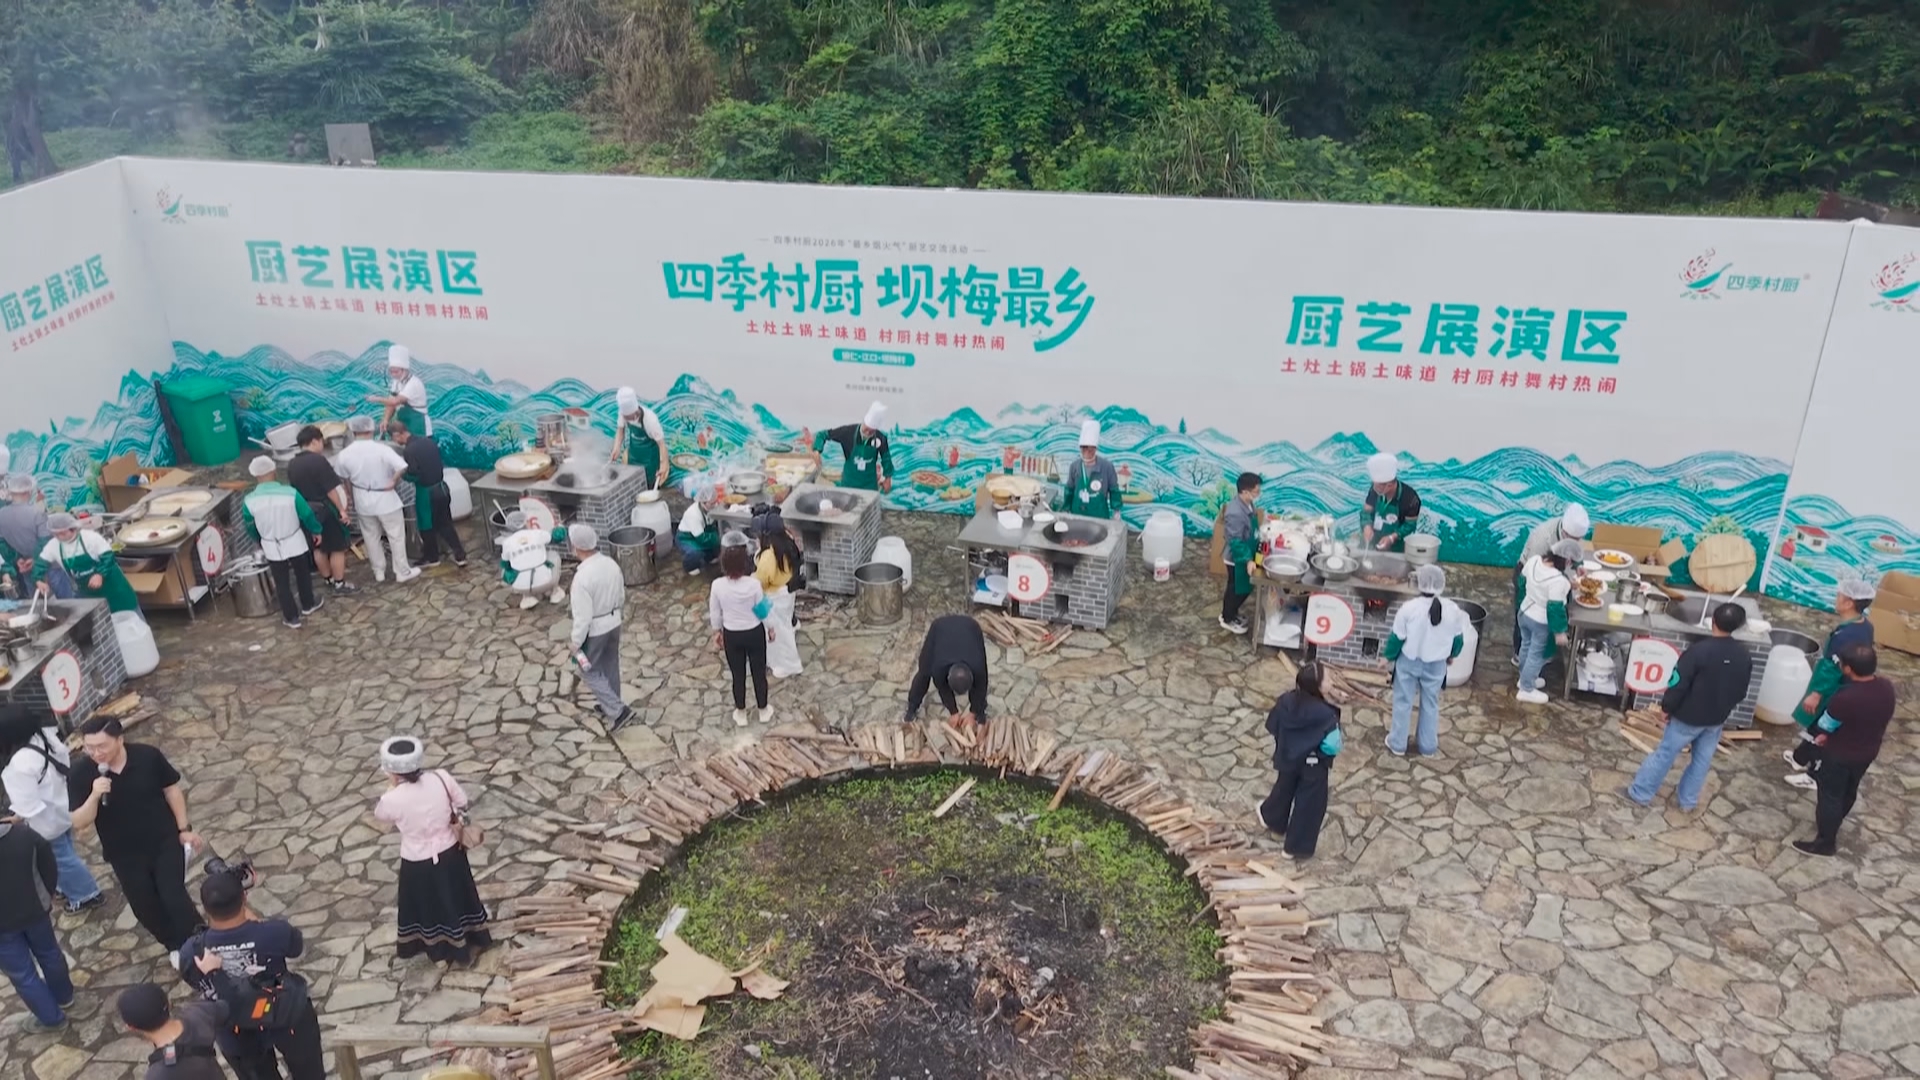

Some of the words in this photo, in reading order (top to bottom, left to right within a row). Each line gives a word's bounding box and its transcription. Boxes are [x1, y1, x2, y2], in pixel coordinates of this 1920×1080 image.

[244, 240, 484, 297] 厨艺展演区
[0, 254, 109, 332] 厨艺展演区
[1726, 275, 1801, 292] 四季村厨
[256, 293, 366, 313] 土灶土锅土味道
[375, 300, 490, 321] 村厨村舞村热闹
[662, 252, 865, 314] 四季村厨
[876, 263, 1096, 353] 坝梅最乡
[746, 319, 868, 342] 土灶土锅土味道
[878, 327, 1006, 351] 村厨村舞村热闹
[1285, 295, 1628, 365] 厨艺展演区
[1280, 356, 1438, 383] 土灶土锅土味道
[1451, 366, 1618, 395] 村厨村舞村热闹
[206, 546, 217, 563] 4
[1018, 574, 1030, 592] 8
[1315, 615, 1331, 635] 9
[1632, 660, 1664, 684] 10
[57, 677, 70, 701] 3
[210, 942, 256, 952] ACKLAB
